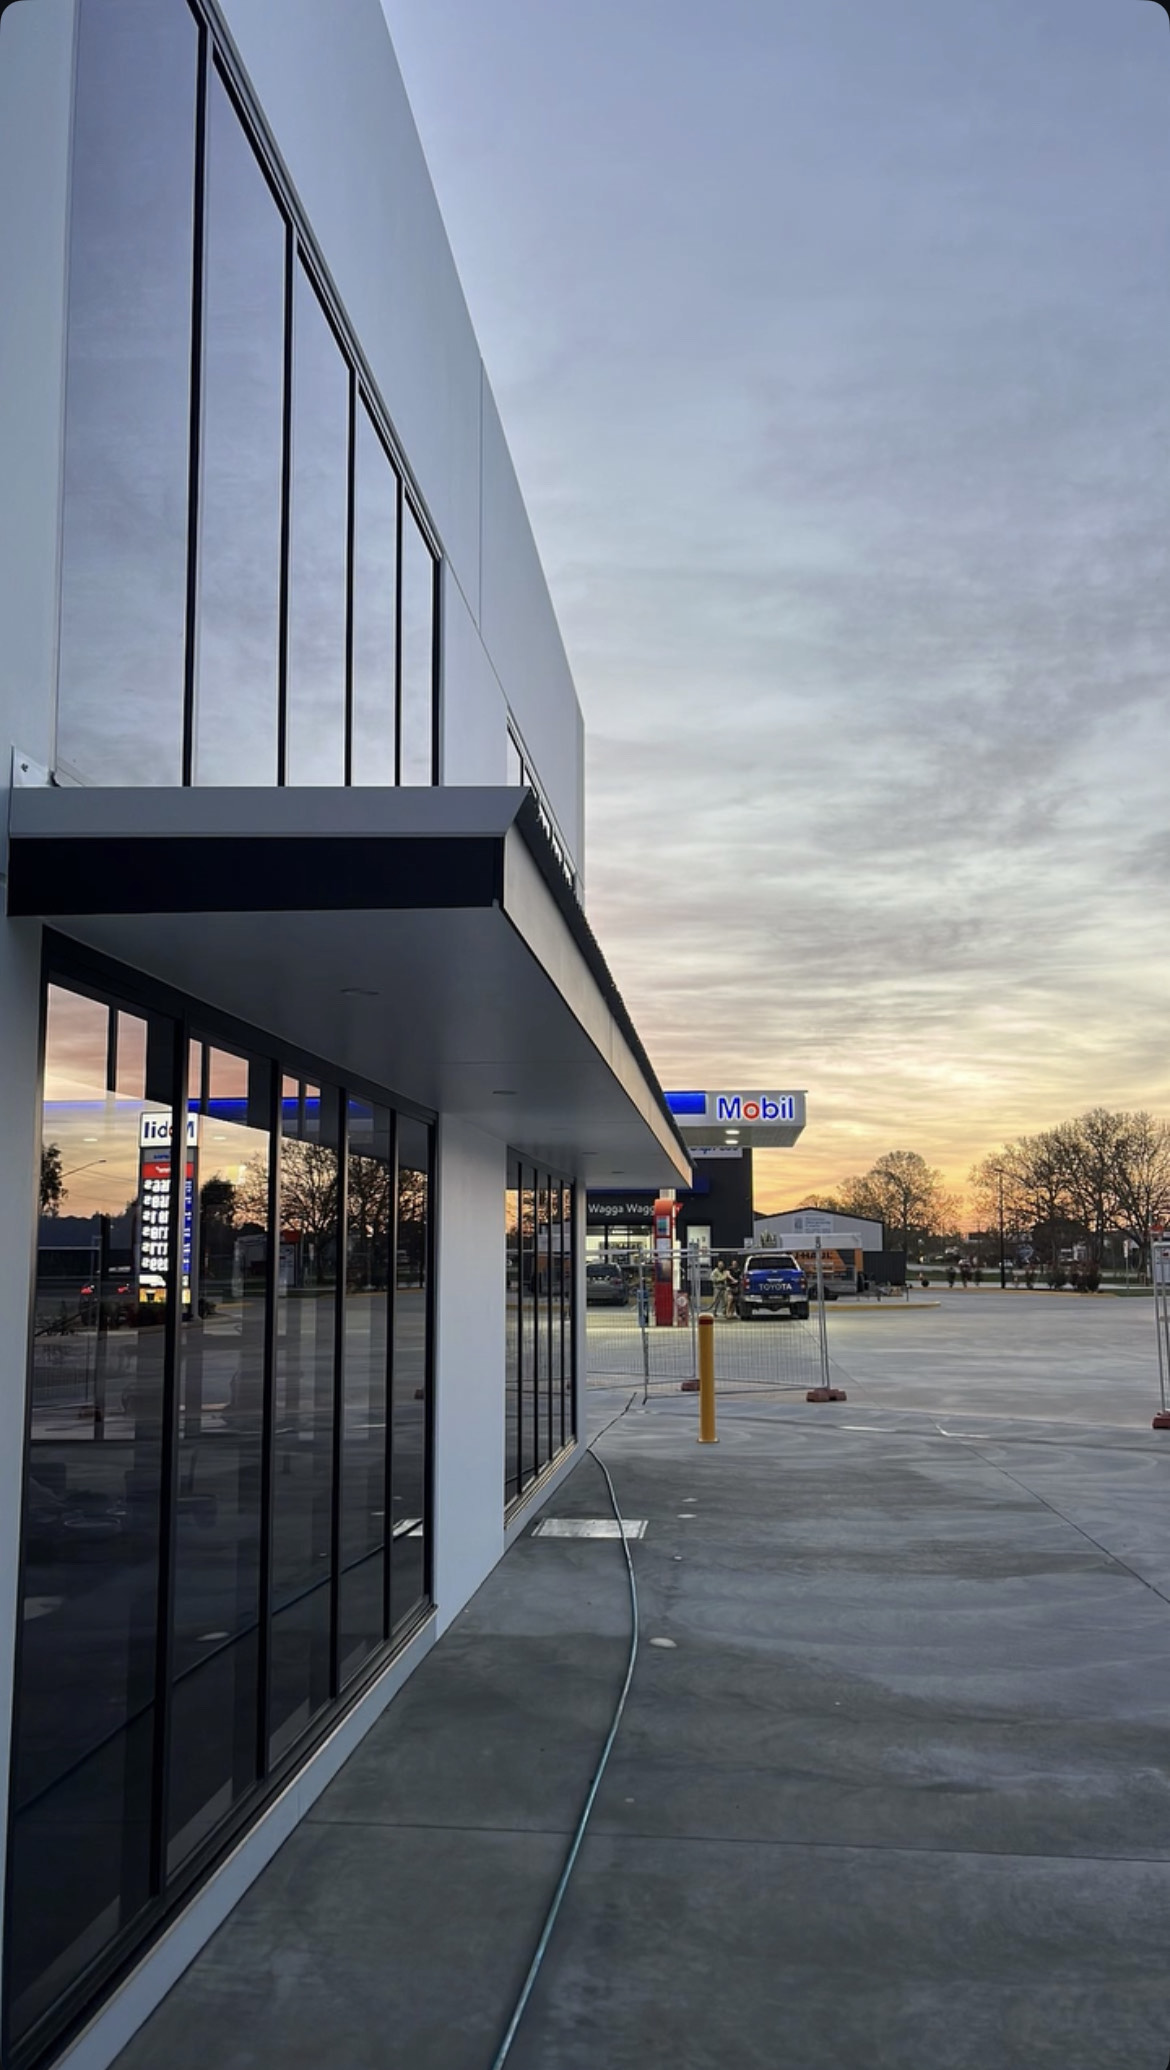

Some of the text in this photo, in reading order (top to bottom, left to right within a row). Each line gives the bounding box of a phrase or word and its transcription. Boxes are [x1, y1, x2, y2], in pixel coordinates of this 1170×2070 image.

[717, 1095, 794, 1120] Mobil
[588, 1203, 655, 1216] Wagga Wagg
[758, 1283, 792, 1291] TOYOTA
